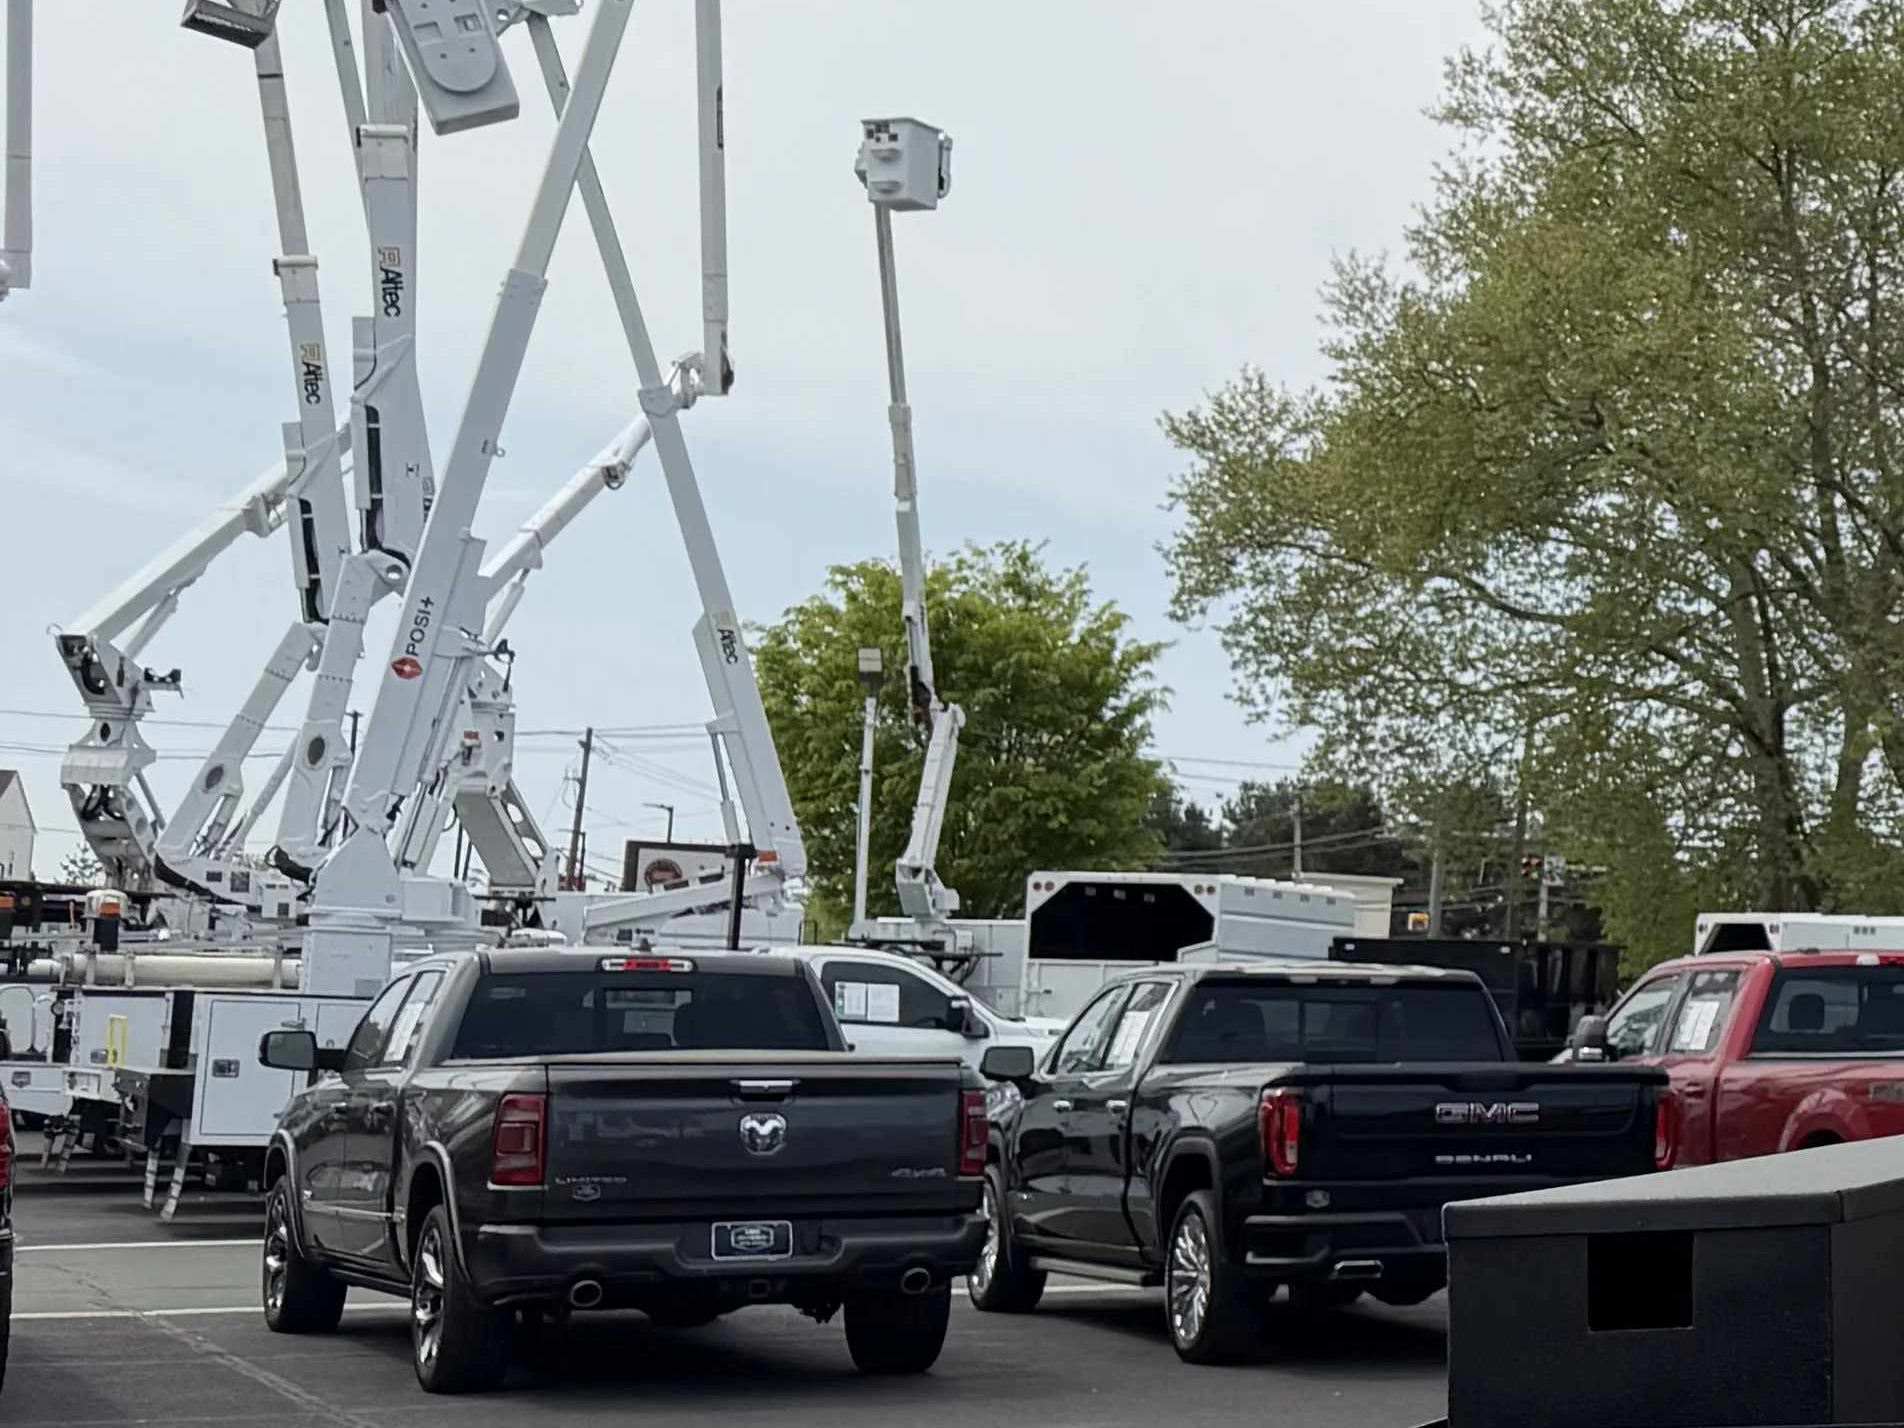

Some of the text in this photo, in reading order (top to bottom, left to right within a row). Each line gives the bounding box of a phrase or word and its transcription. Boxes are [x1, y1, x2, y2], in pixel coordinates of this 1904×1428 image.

[380, 265, 404, 317] Altec
[301, 360, 323, 405] Altec
[405, 595, 435, 657] POSI+
[1435, 1102, 1540, 1125] GMC
